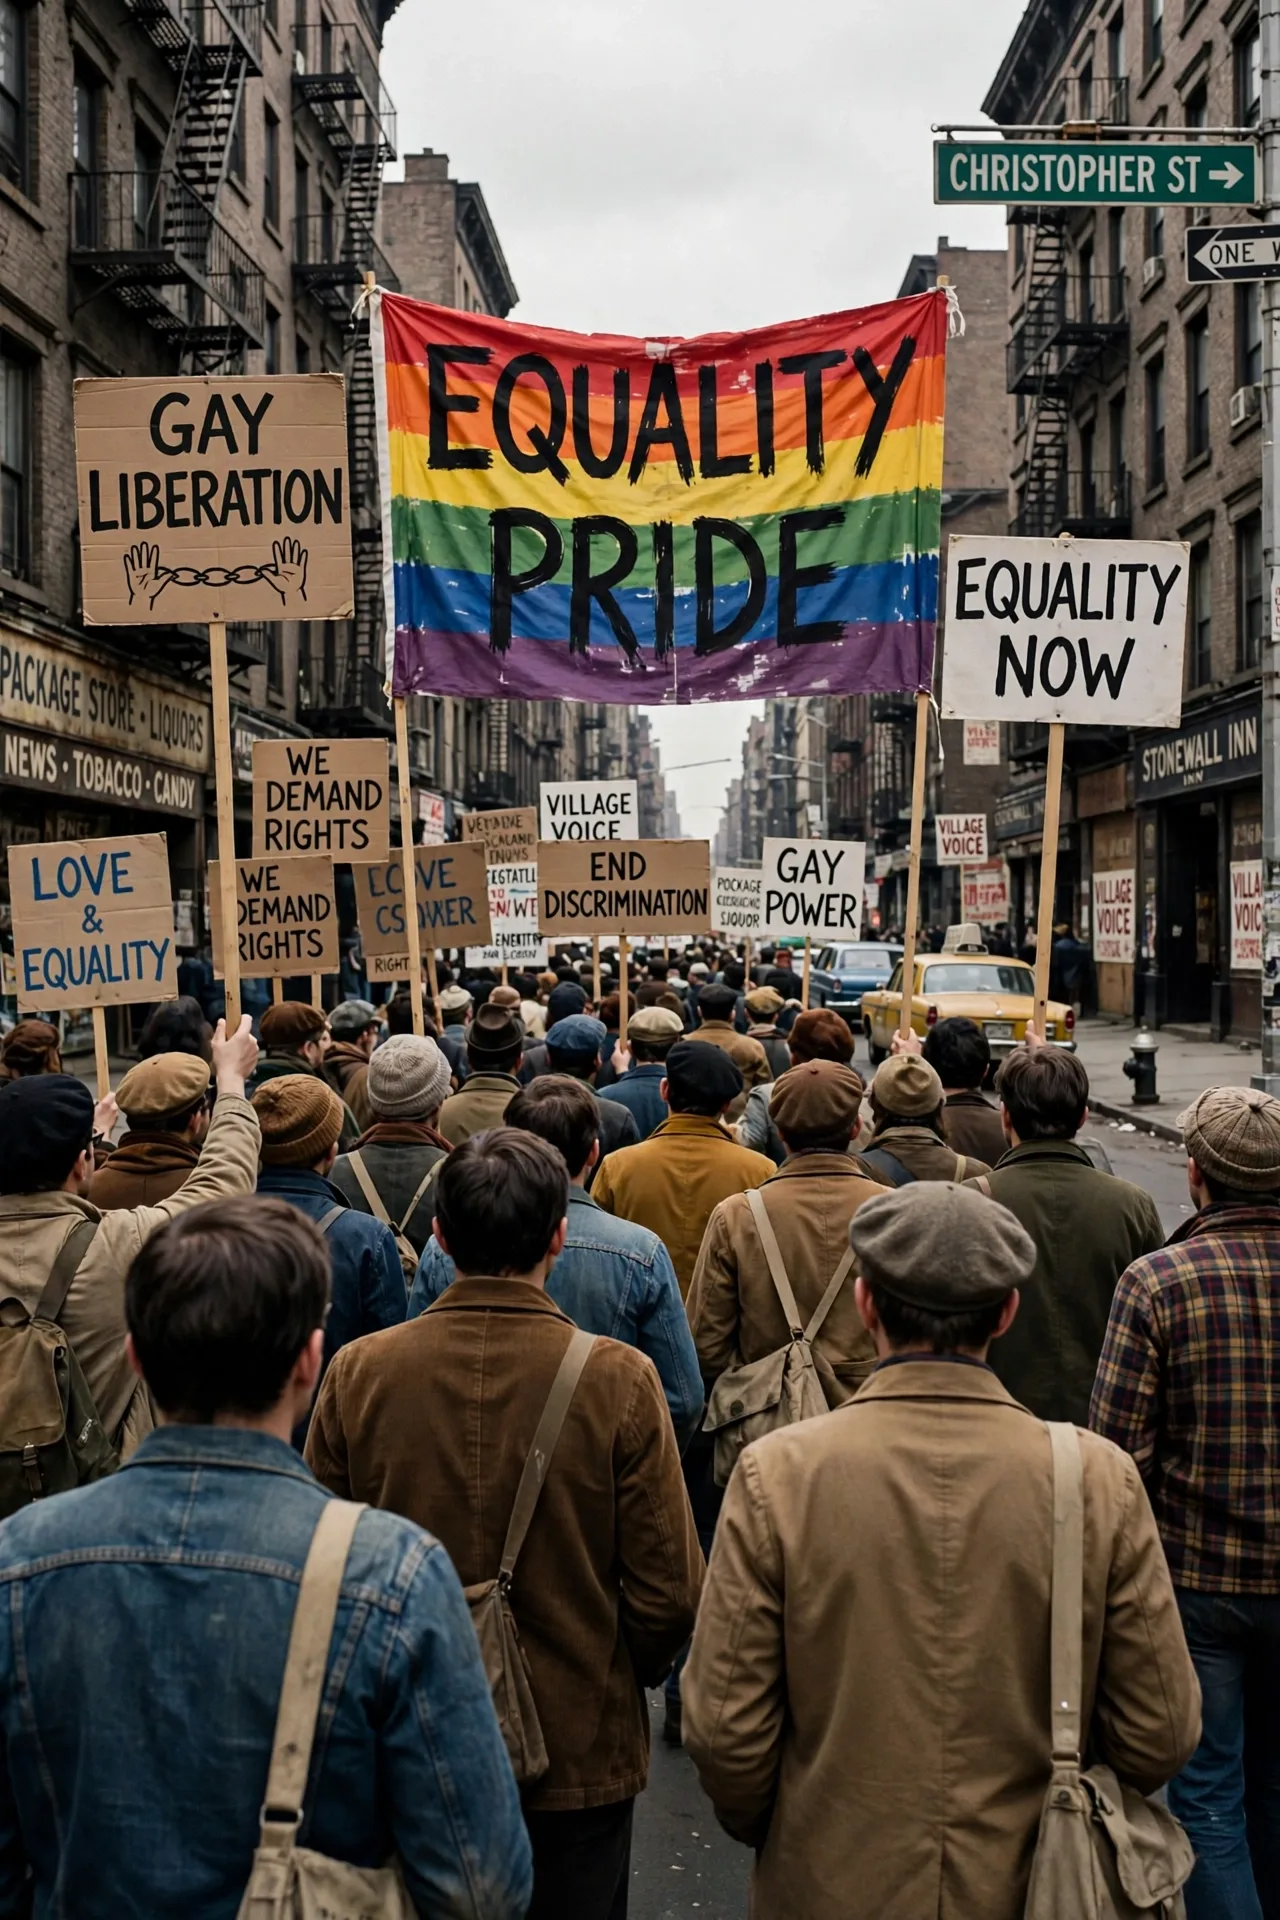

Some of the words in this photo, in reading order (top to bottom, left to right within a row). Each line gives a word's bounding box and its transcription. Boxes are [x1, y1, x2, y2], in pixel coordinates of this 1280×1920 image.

[950, 153, 1156, 193] CHRISTOPHER
[1167, 156, 1201, 193] ST
[1209, 242, 1255, 265] ONE
[150, 392, 274, 456] GAY
[426, 335, 917, 486] EQUALITY
[89, 467, 342, 532] LIBERATION
[488, 506, 849, 670] PRIDE
[955, 557, 1181, 625] EQUALITY
[995, 635, 1135, 700] NOW
[0, 645, 81, 717] PACKAGE
[89, 678, 135, 734] STORE
[150, 699, 204, 754] LIQUORS
[286, 746, 330, 776] WE
[1142, 728, 1223, 782] STONEWALL
[1228, 716, 1257, 760] INN
[5, 734, 58, 783] NEWS
[73, 750, 142, 799] TOBACCO
[154, 770, 195, 810] CANDY
[267, 779, 382, 812] DEMAND
[547, 793, 632, 816] VILLAGE
[265, 818, 369, 850] RIGHTS
[551, 820, 621, 840] VOICE
[938, 818, 984, 834] VILLAGE
[942, 836, 984, 855] VOICE
[31, 851, 134, 901] LOVE
[240, 865, 280, 893] WE
[590, 851, 647, 881] END
[776, 847, 845, 885] GAY
[1095, 878, 1132, 905] VILLAGE
[1232, 872, 1263, 898] VILLA
[82, 904, 103, 934] &
[544, 888, 708, 918] DISCRIMINATION
[765, 890, 857, 929] POWER
[1234, 903, 1262, 931] VOIC
[1096, 908, 1131, 934] VOICE
[23, 938, 170, 992] EQUALITY
